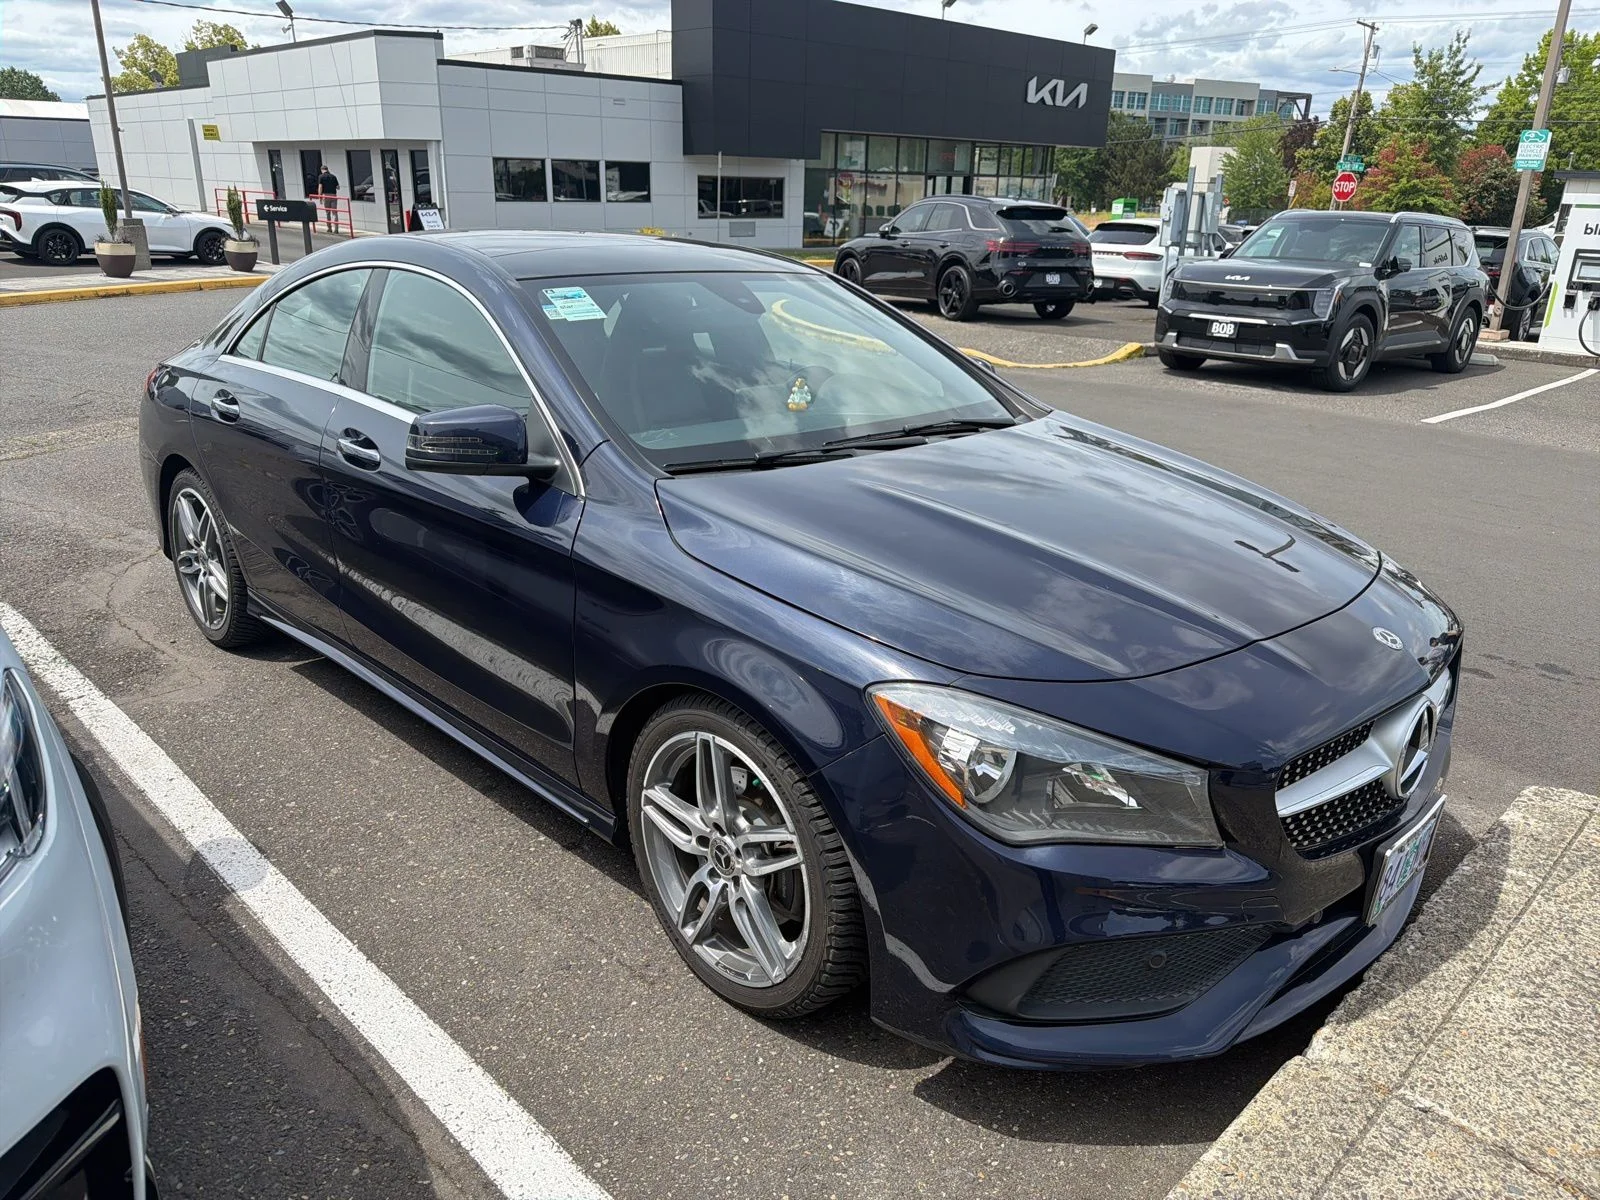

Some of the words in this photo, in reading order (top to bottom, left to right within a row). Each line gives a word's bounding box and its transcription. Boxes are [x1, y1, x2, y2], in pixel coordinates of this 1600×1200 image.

[1026, 76, 1088, 109] KIA
[1334, 181, 1355, 193] STOP
[1211, 321, 1235, 335] BOB
